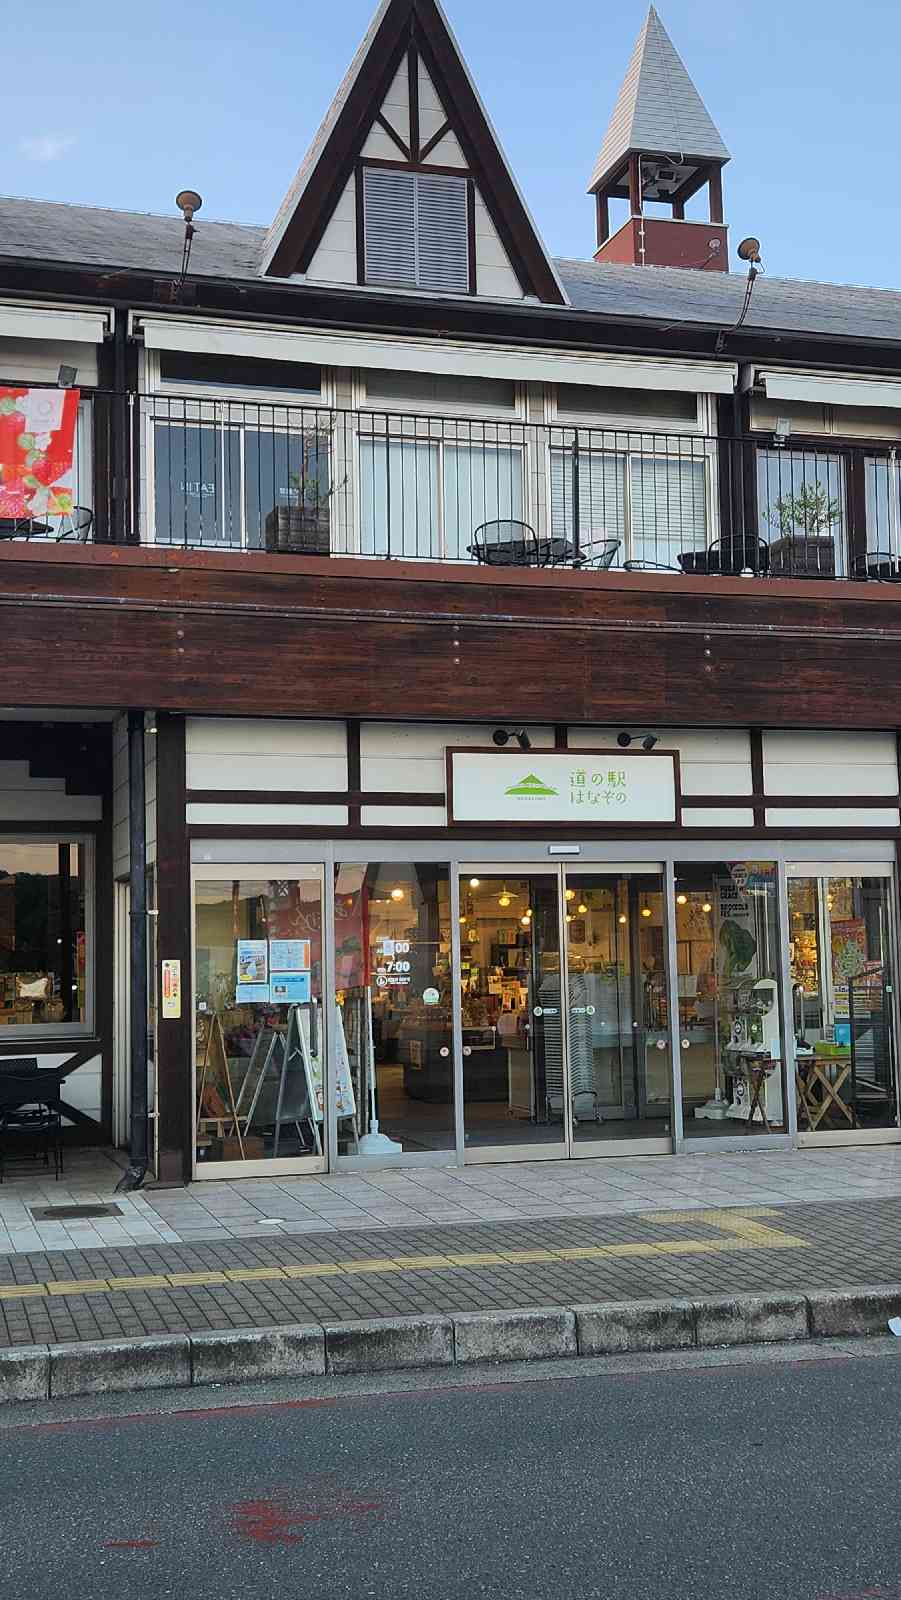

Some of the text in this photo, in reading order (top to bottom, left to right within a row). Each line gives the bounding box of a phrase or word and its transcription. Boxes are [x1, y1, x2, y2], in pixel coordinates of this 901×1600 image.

[569, 768, 627, 788] 道の駅
[570, 789, 627, 805] はなぞの
[386, 961, 410, 973] 7:00
